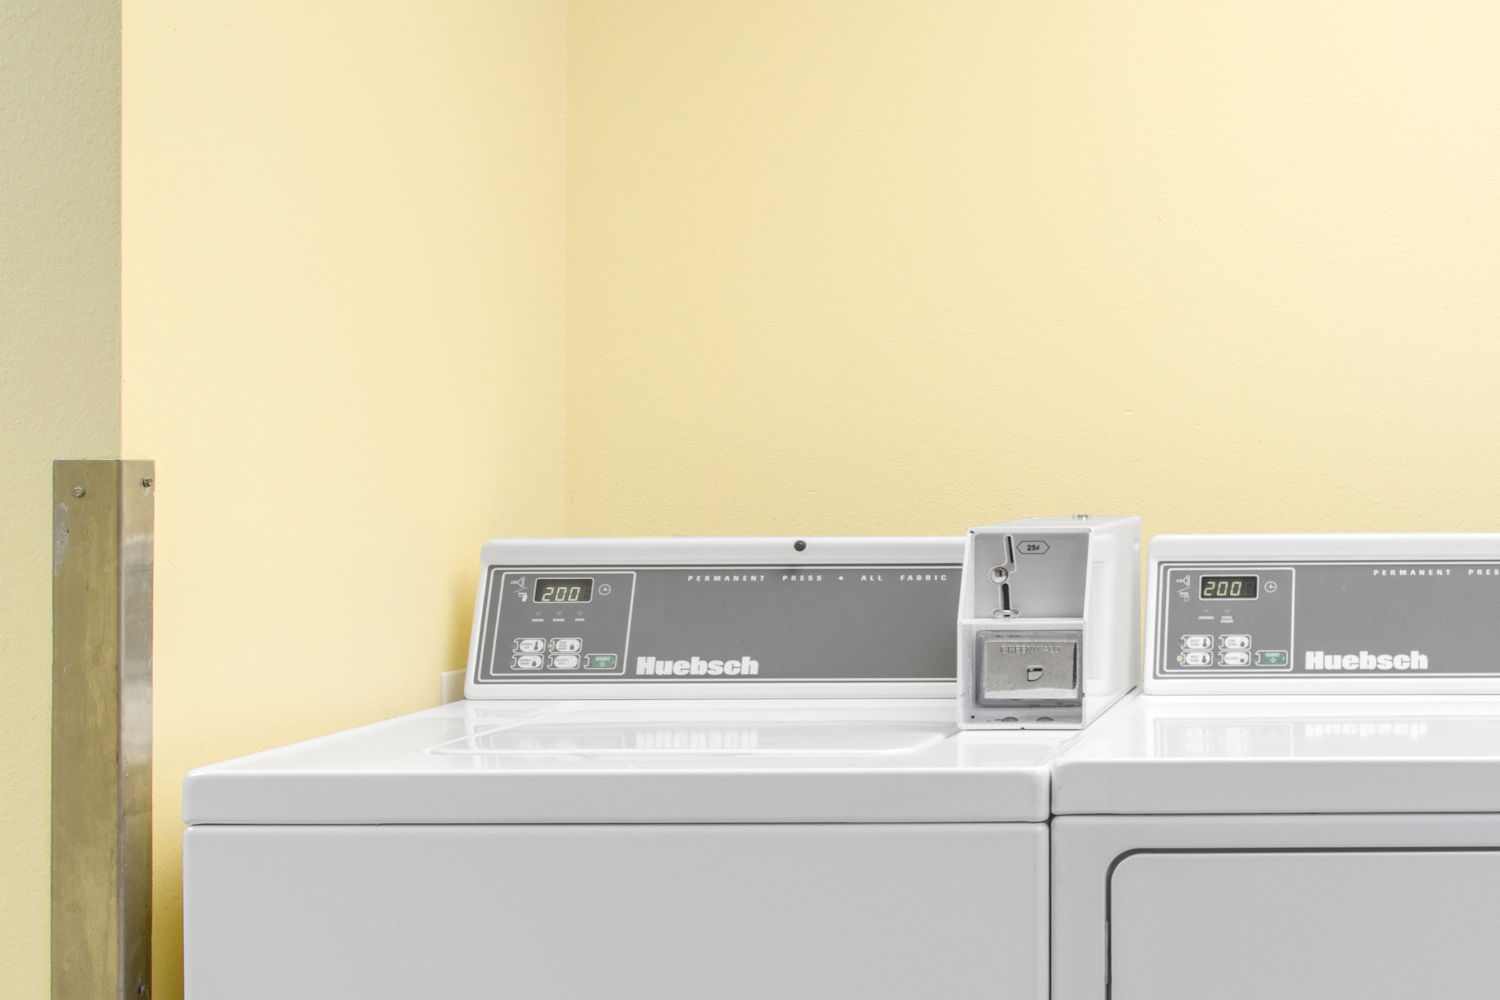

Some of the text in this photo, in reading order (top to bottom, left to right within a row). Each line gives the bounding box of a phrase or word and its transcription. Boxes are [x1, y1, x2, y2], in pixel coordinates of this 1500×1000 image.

[782, 574, 822, 582] PRESS
[860, 574, 883, 582] ALL
[1373, 568, 1451, 576] PERMANENT
[541, 586, 581, 601] 200
[1203, 581, 1242, 596] 200
[636, 656, 759, 676] Huebsch
[1305, 650, 1428, 670] Huebsch
